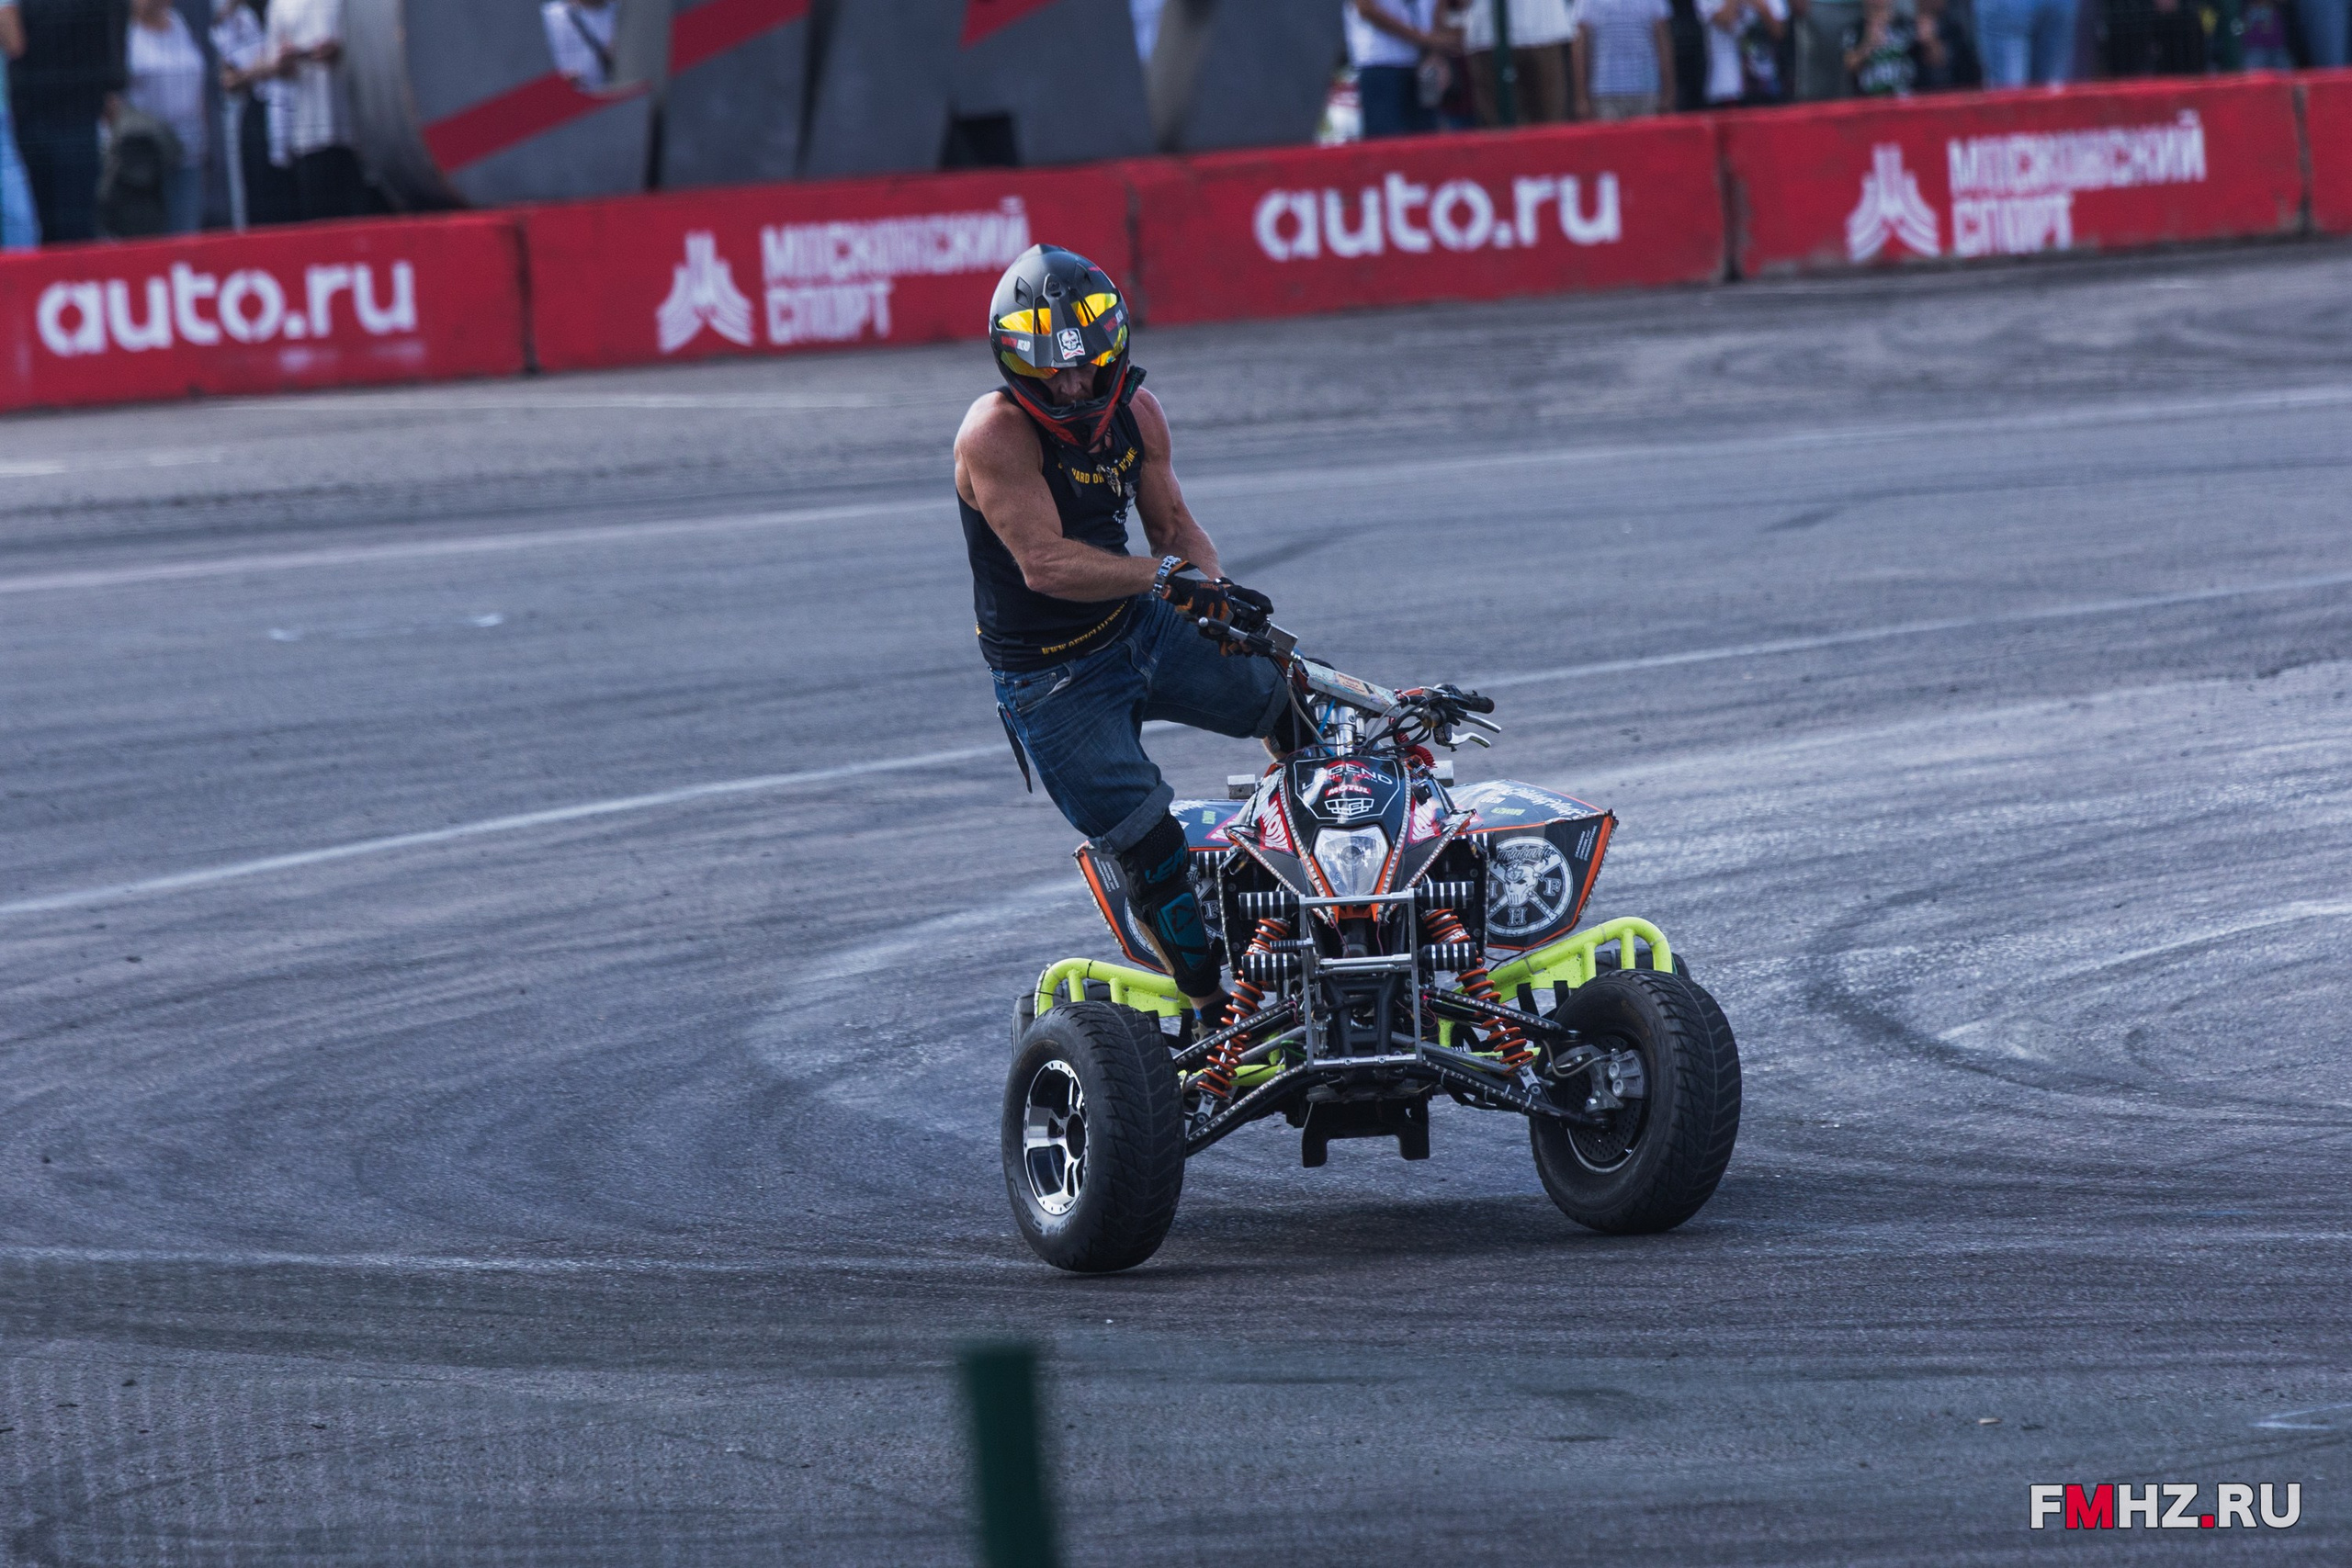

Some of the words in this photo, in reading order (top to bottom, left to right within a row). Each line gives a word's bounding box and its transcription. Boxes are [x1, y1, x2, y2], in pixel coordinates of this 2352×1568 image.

[1948, 109, 2204, 189] МОСКОВСКИЙ
[762, 196, 1029, 278] МОСКОВСКИЙ
[1254, 172, 1622, 262] auto.ru
[1951, 194, 2072, 256] СПОРТ
[36, 261, 417, 357] auto.ru
[765, 280, 891, 344] СПОРТ
[1302, 763, 1393, 790] LGEND
[1327, 784, 1370, 796] MOTUL
